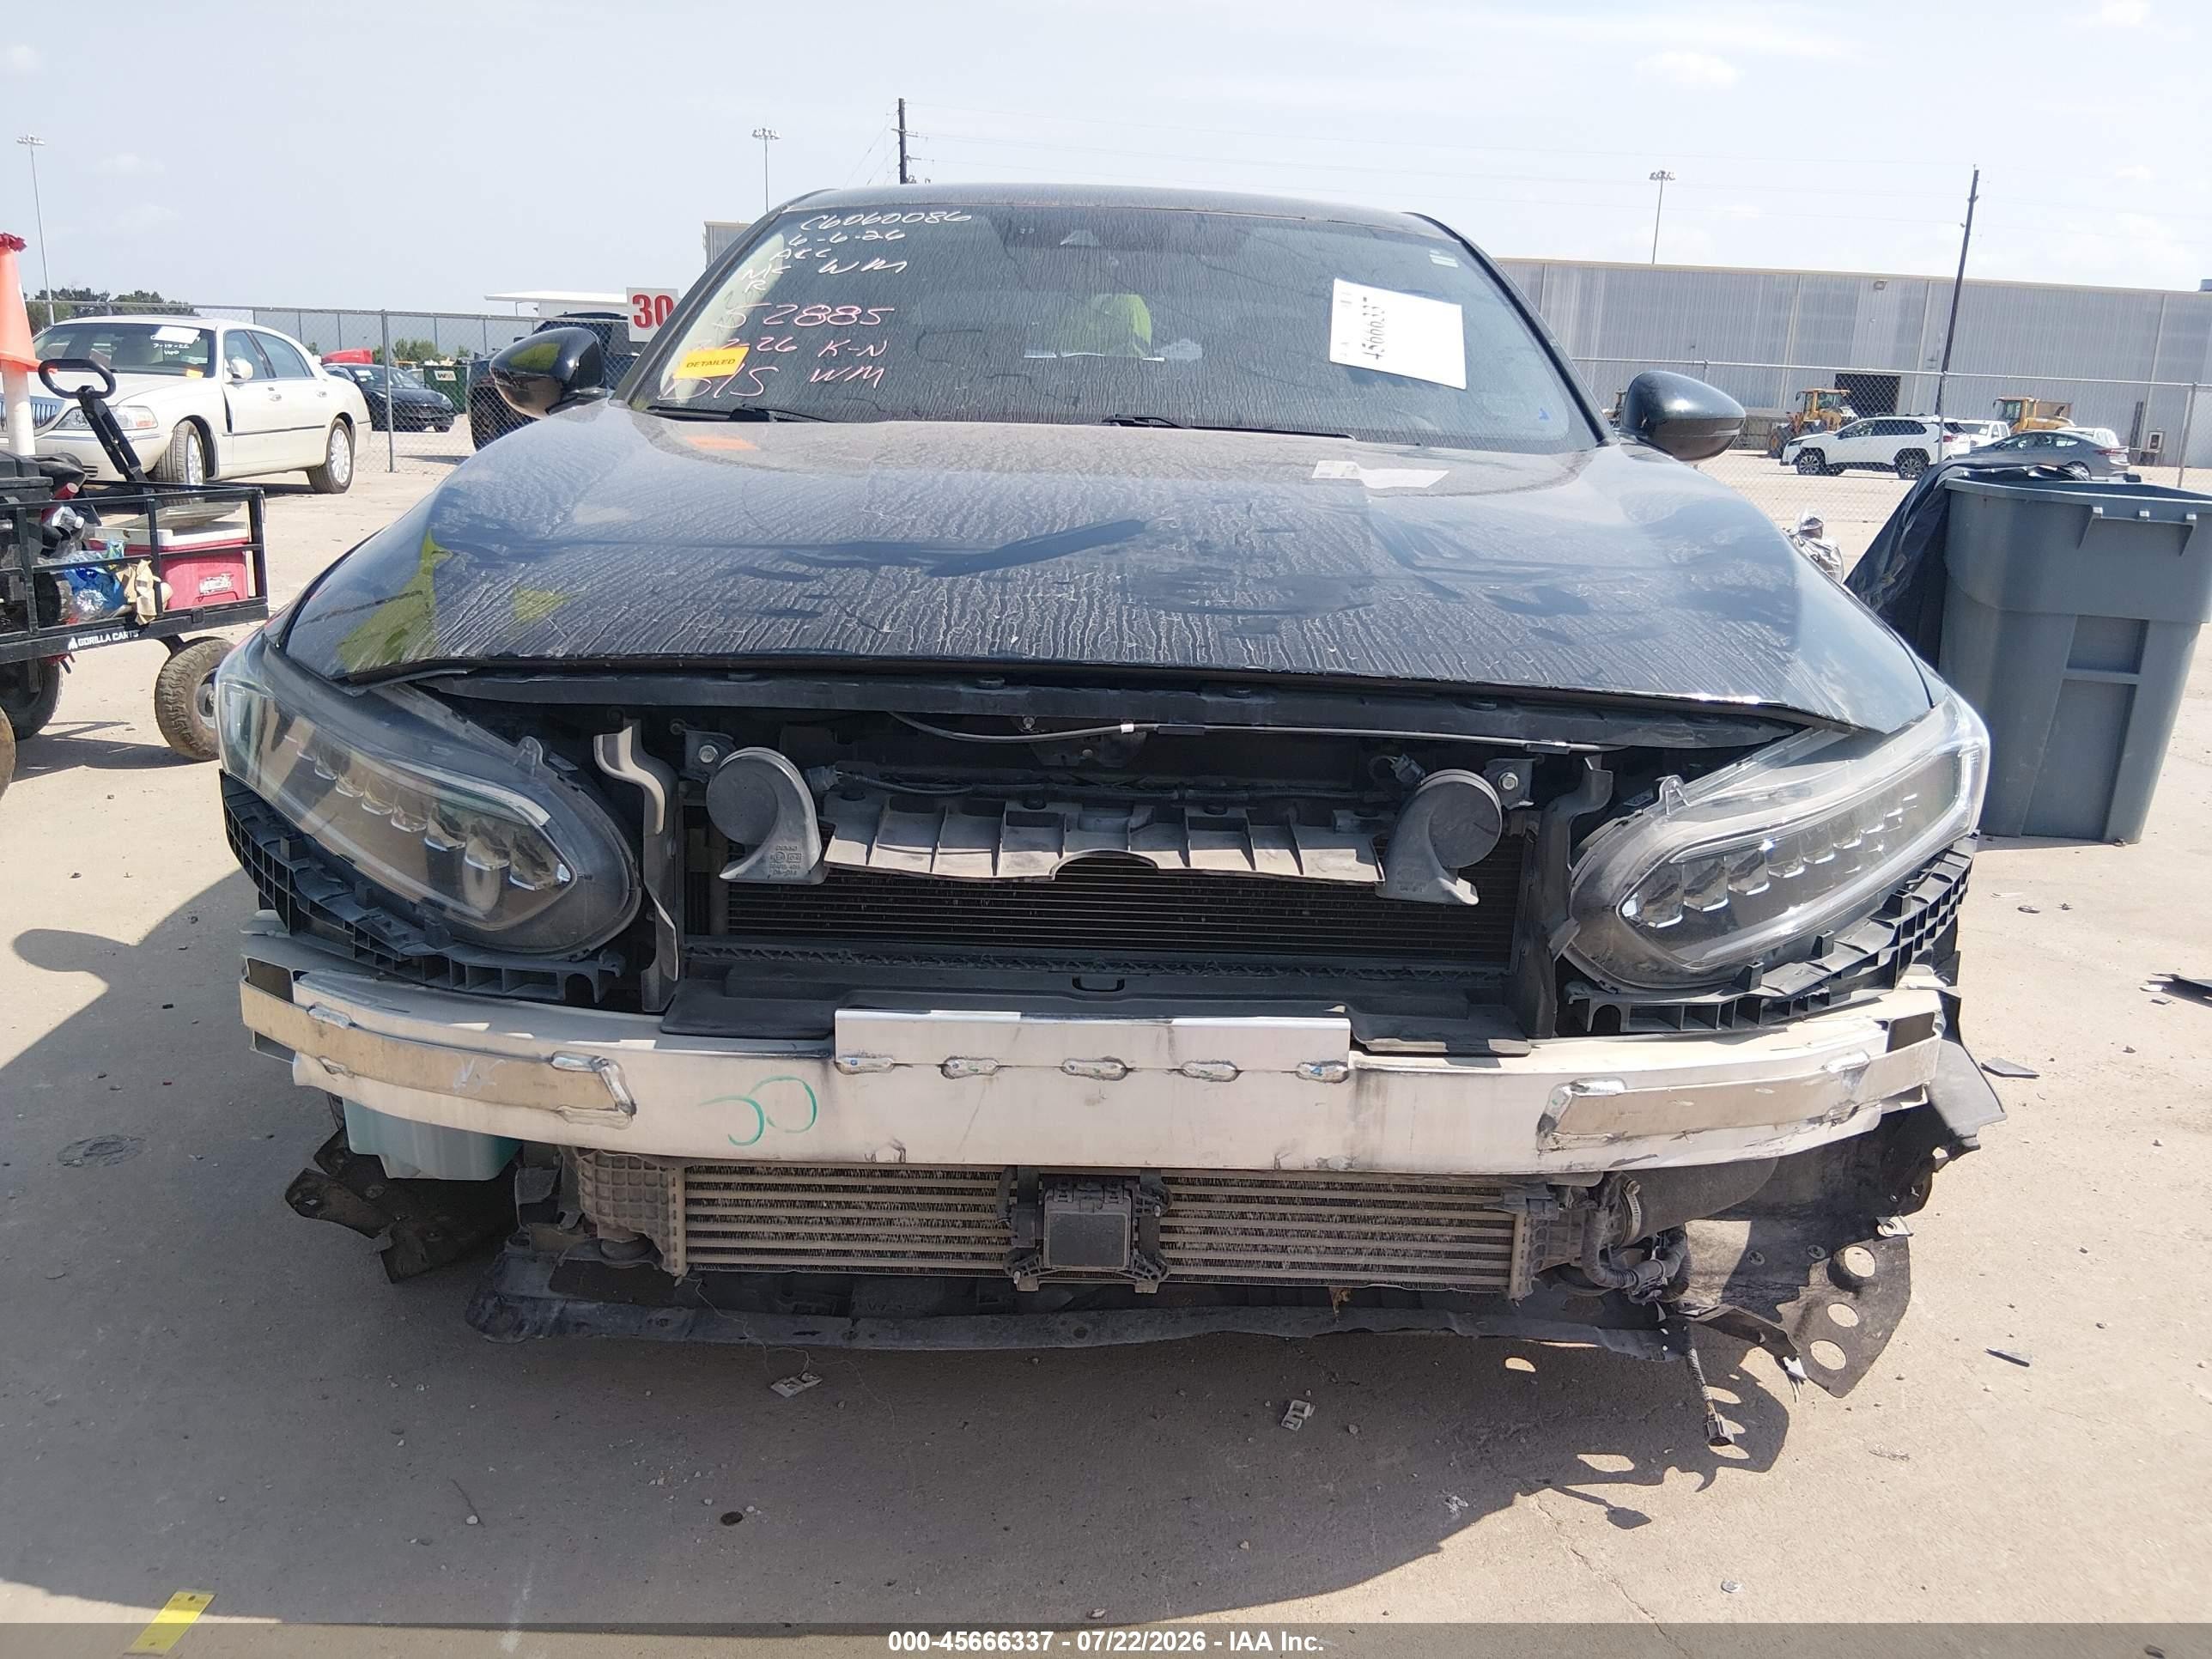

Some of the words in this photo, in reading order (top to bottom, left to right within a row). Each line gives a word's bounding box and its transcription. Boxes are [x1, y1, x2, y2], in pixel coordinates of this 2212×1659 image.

[799, 211, 972, 230] C6060086
[632, 294, 674, 328] 30
[711, 302, 895, 329] 52885
[686, 358, 736, 368] DETAILED
[77, 634, 112, 646] GORILLA
[112, 629, 139, 641] CARTS
